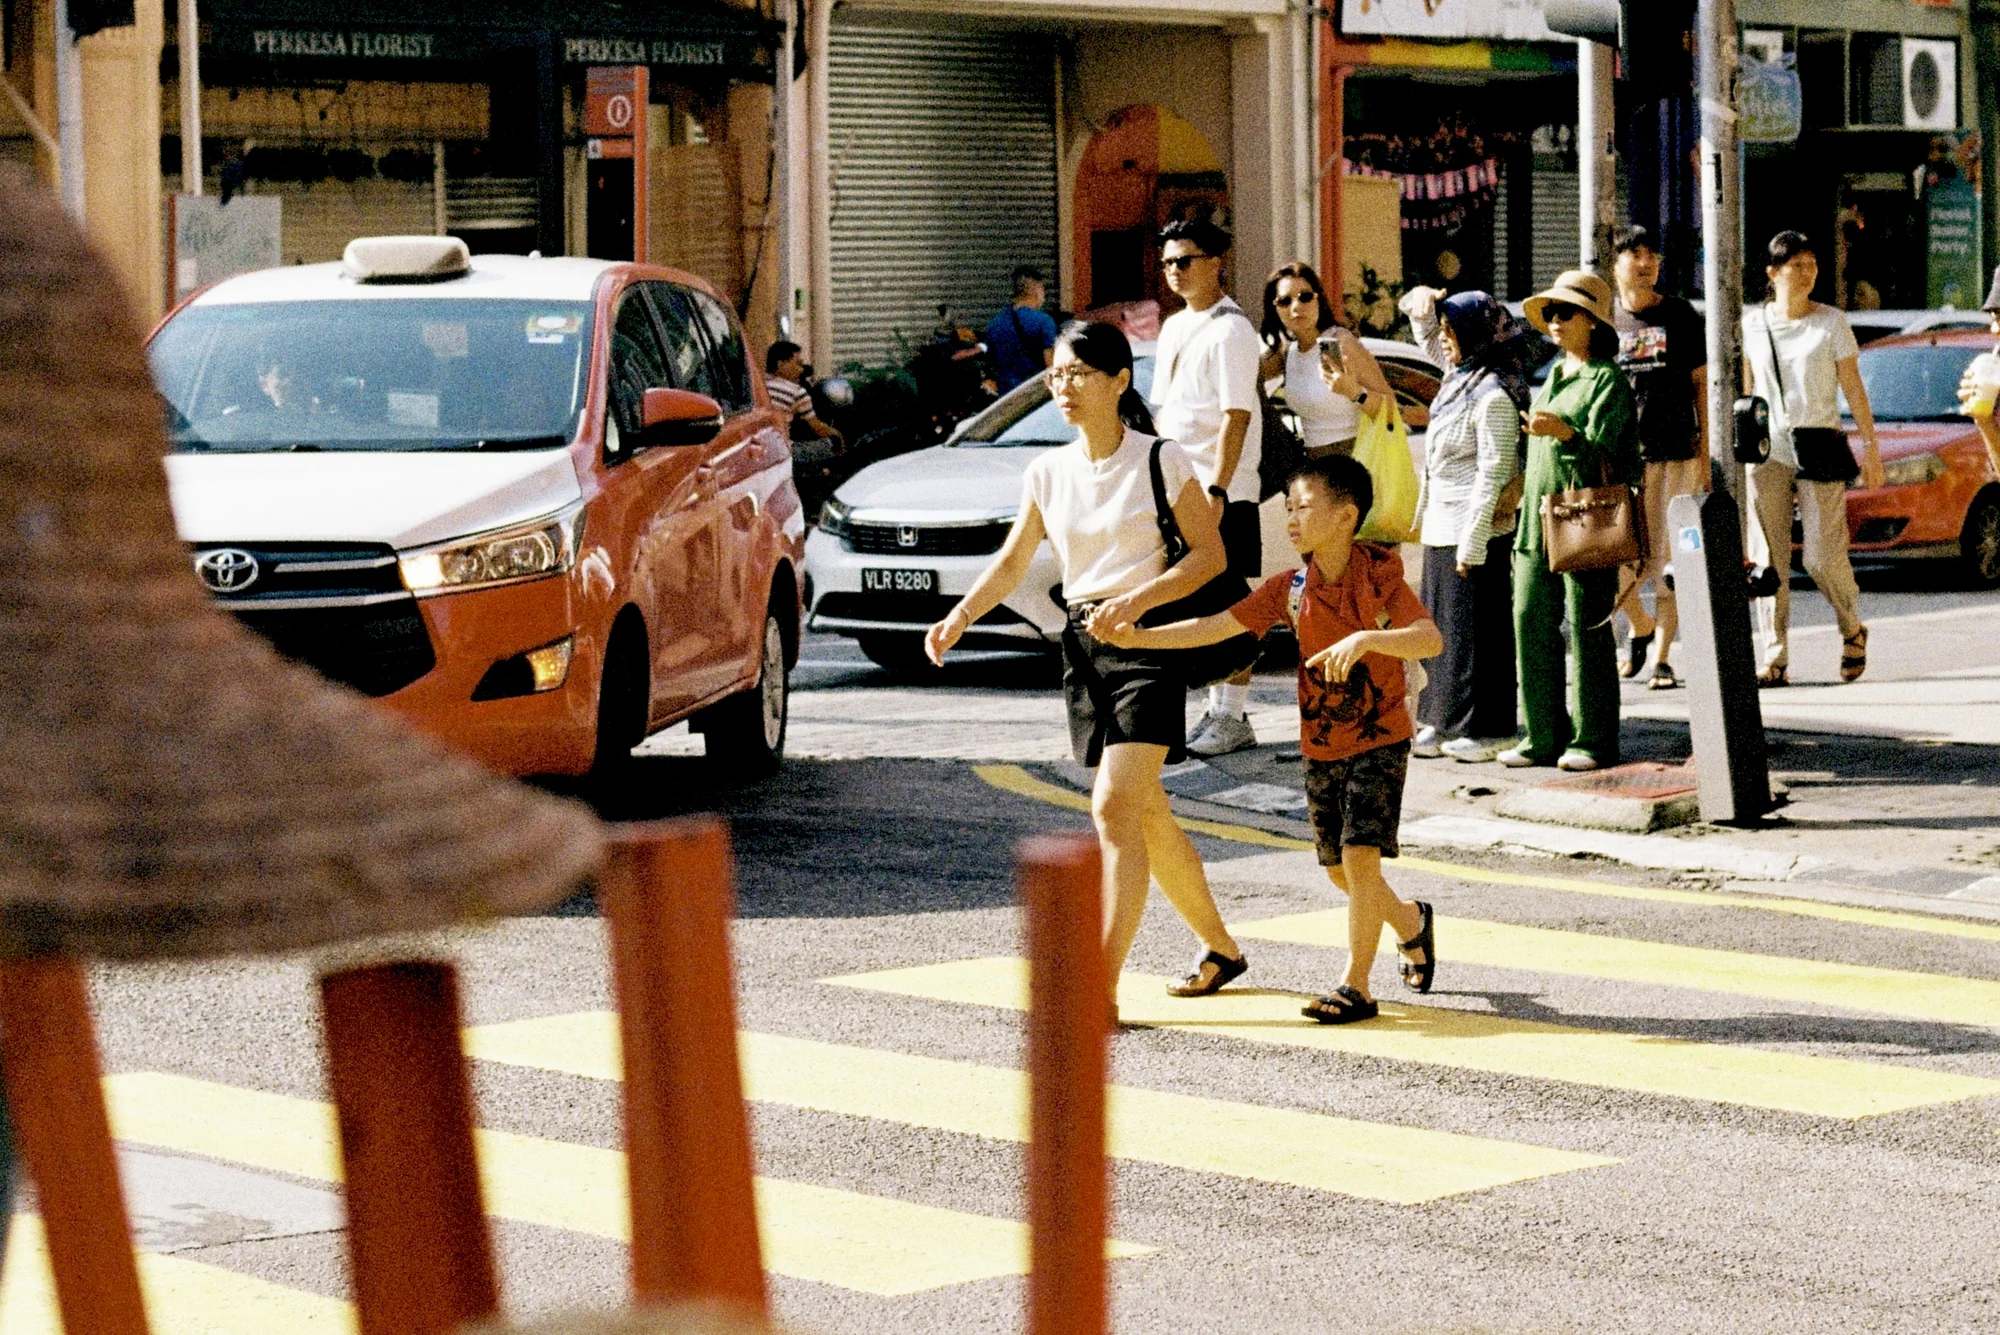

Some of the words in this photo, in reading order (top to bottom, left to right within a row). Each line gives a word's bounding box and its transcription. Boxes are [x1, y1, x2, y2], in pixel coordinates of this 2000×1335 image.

[253, 30, 346, 55] PERKESA
[351, 32, 434, 57] FLORIST
[564, 38, 647, 62] PERKESA
[651, 41, 725, 64] FLORIST
[865, 570, 892, 590] VLR
[895, 571, 932, 591] 9280
